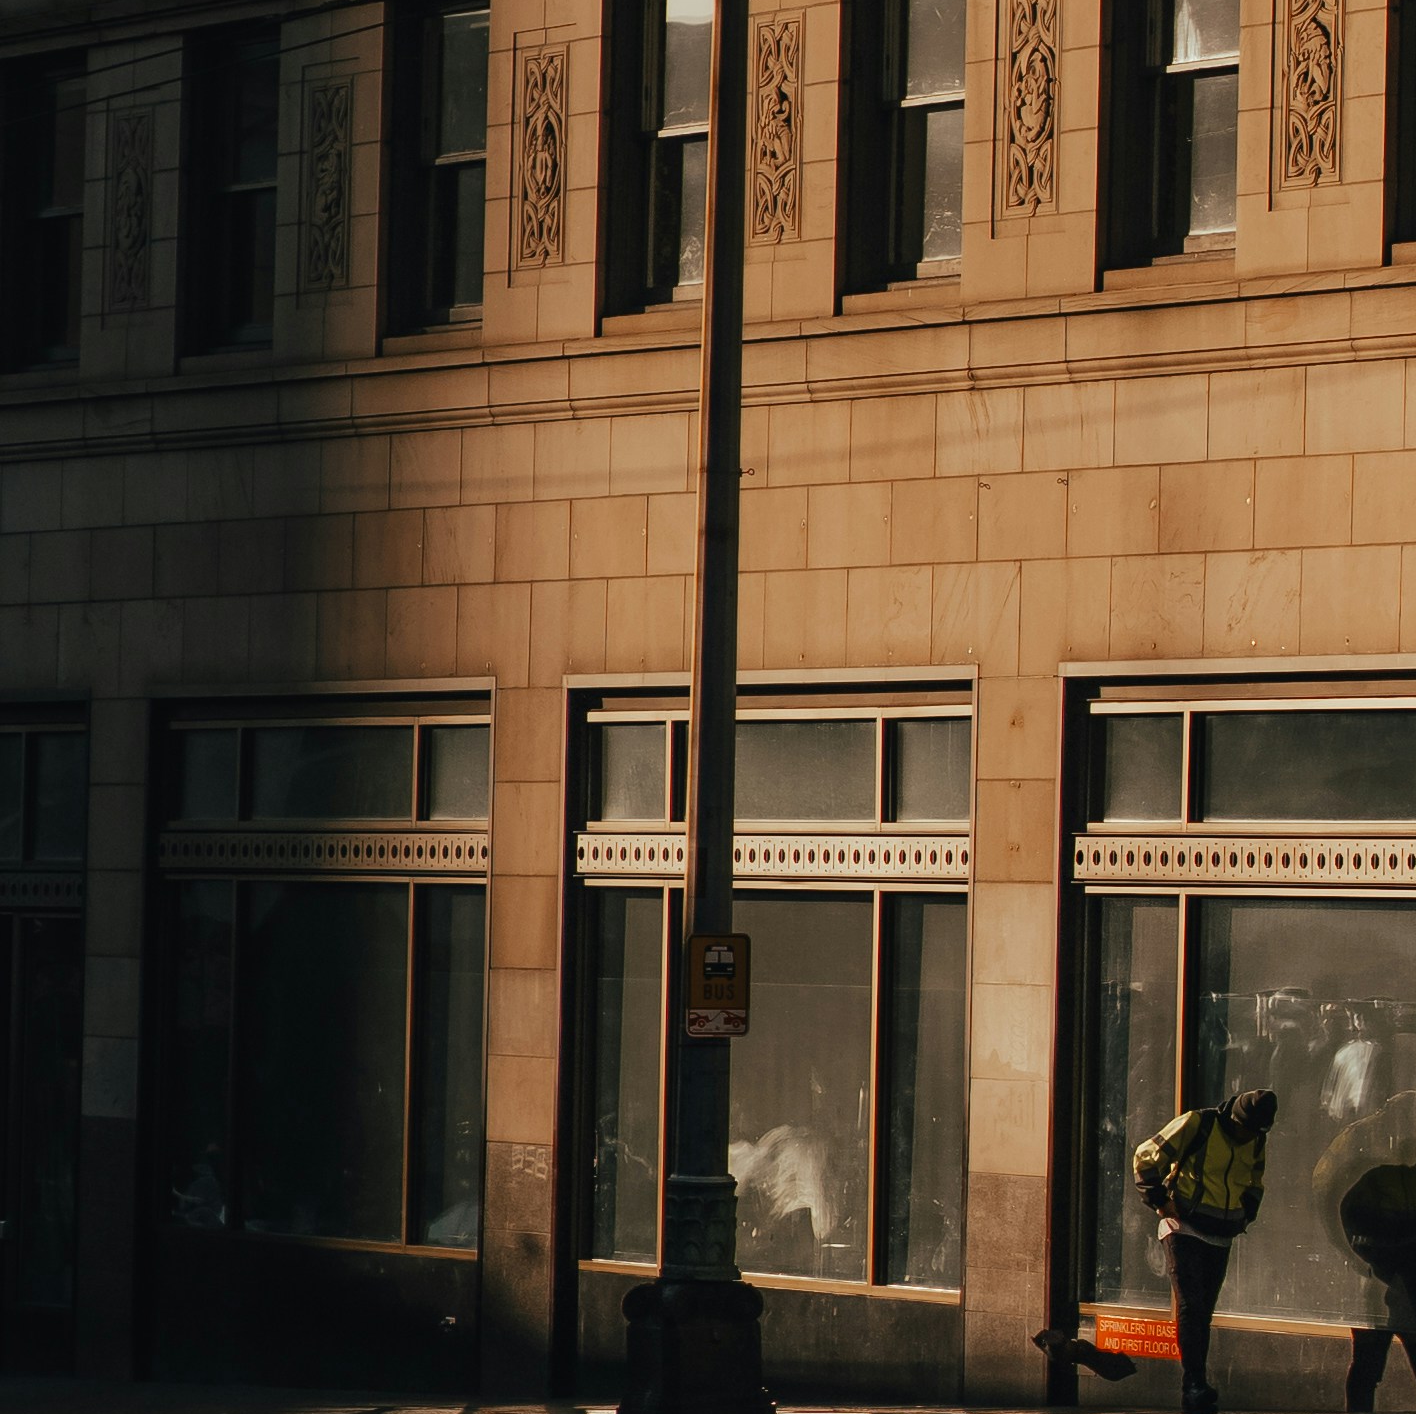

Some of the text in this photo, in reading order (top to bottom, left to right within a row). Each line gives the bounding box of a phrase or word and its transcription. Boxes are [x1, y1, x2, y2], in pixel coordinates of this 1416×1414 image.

[703, 983, 735, 1000] BUS
[1099, 1319, 1176, 1338] SPRINKLERS IN BASE
[1104, 1337, 1120, 1349] AND
[1121, 1339, 1143, 1351] FIRST
[1144, 1341, 1170, 1355] FLOOR
